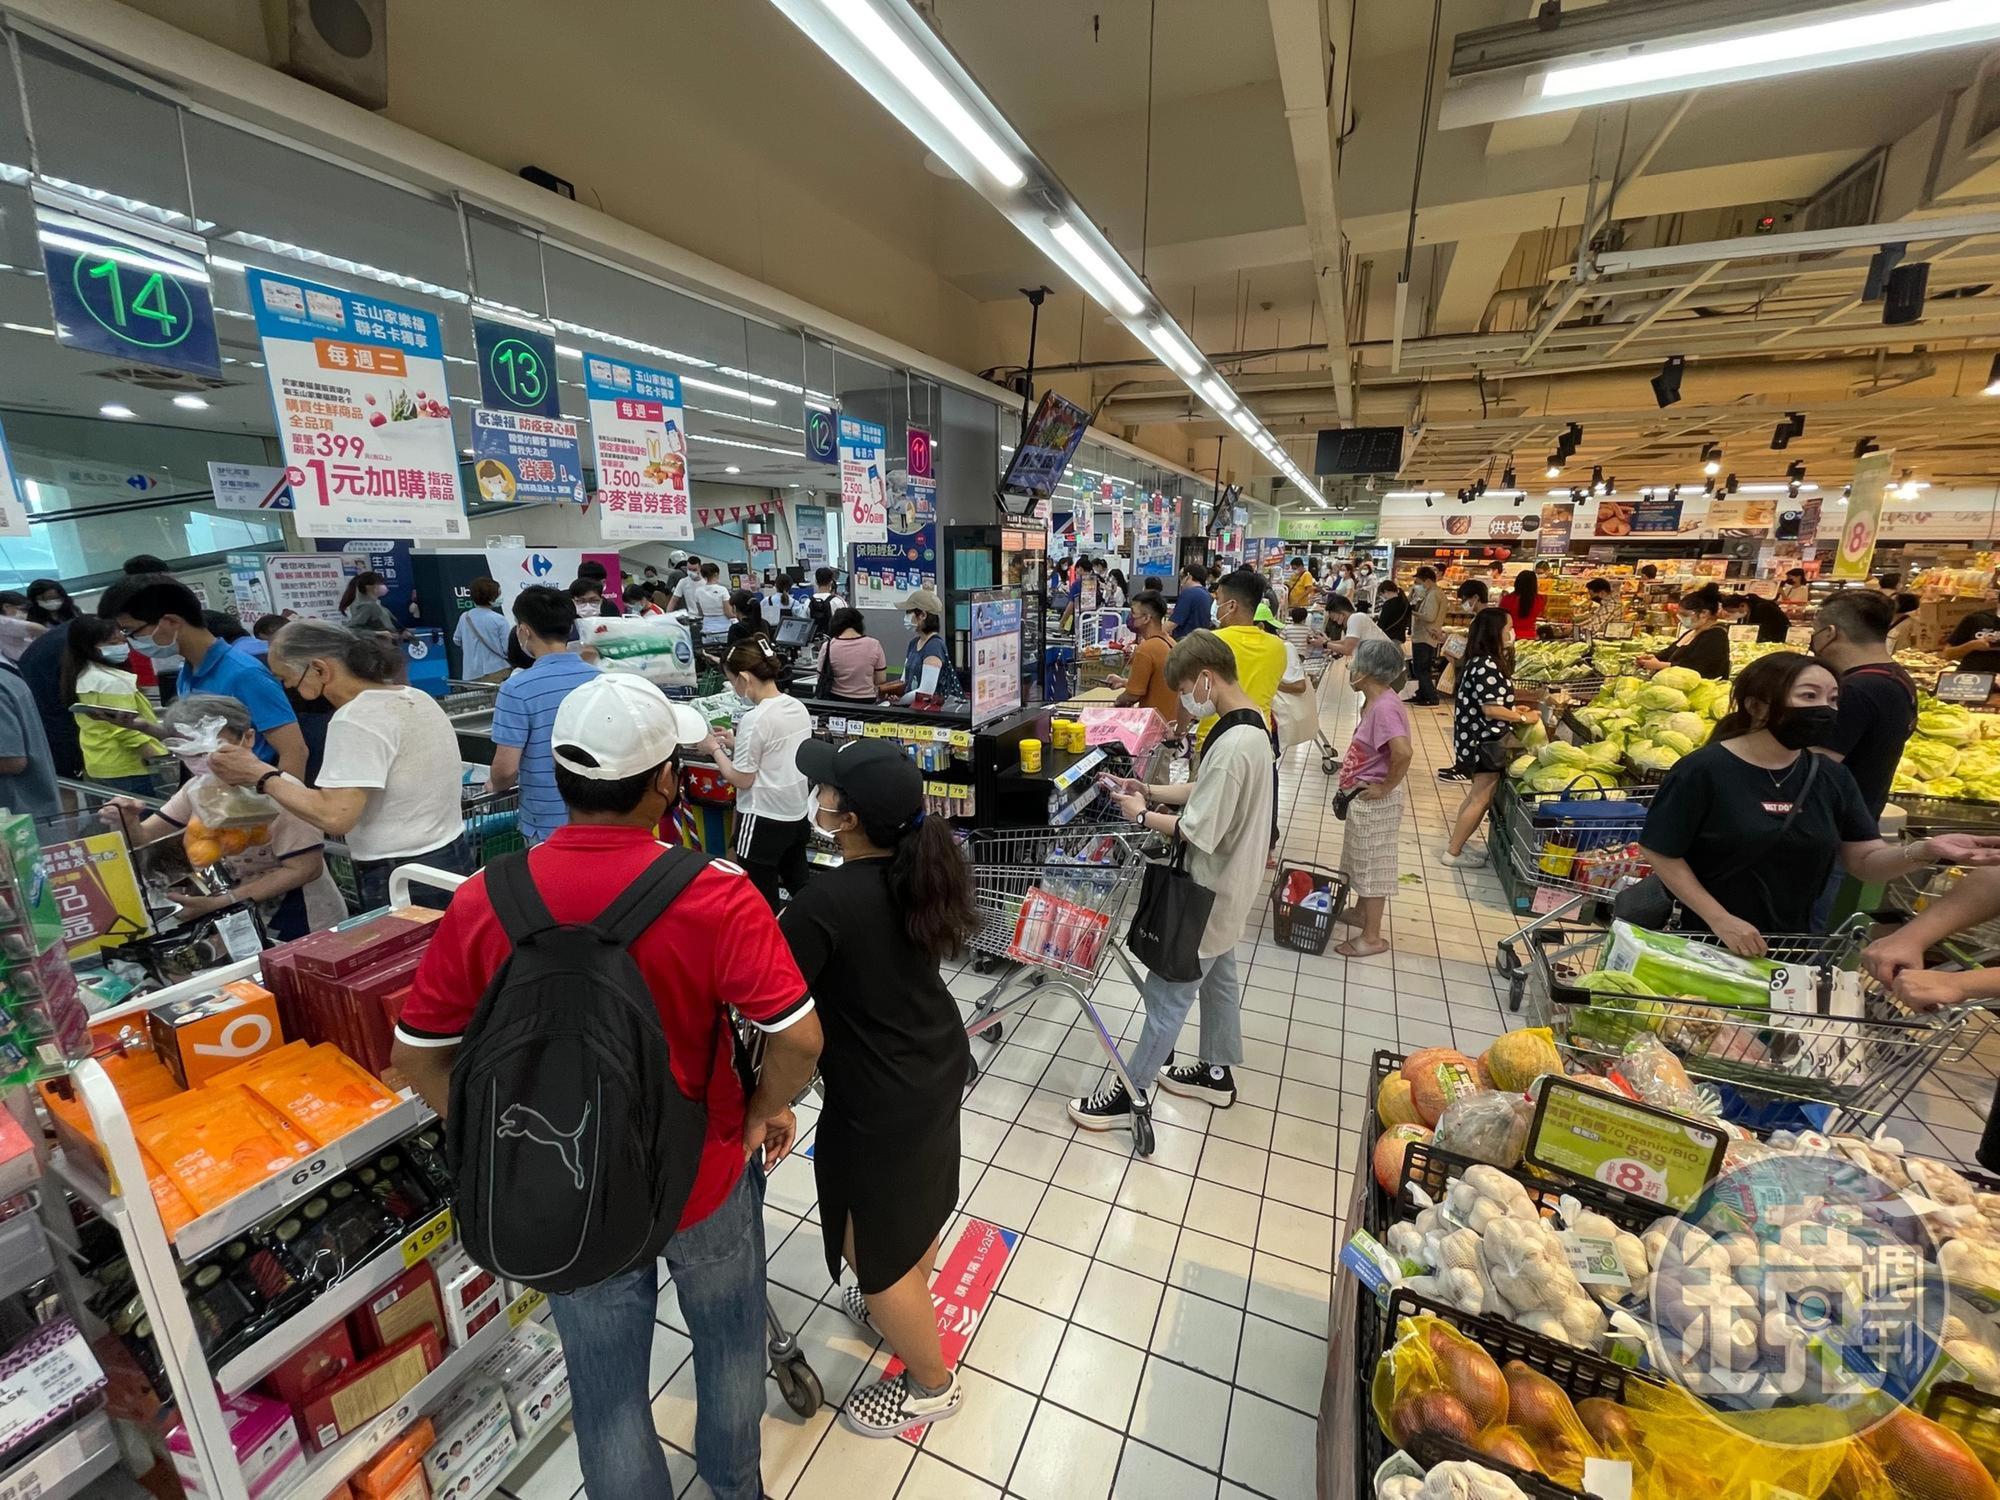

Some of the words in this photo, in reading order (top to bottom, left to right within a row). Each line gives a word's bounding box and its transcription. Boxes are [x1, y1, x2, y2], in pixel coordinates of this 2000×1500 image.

[89, 259, 177, 337] 14
[351, 301, 426, 332] 玉山家樂福
[354, 319, 428, 349] 聯名卡獨享
[327, 344, 399, 372] 每週二
[499, 349, 541, 399] 13
[285, 398, 364, 420] 購買生鮮商品
[621, 402, 660, 419] 每週一
[289, 414, 334, 431] 全品項
[811, 419, 830, 451] 12
[316, 433, 365, 459] 399
[913, 443, 925, 468] 11
[305, 458, 427, 507] 1元加購
[428, 471, 454, 488] 指定
[517, 457, 557, 483] 消毒
[602, 468, 640, 489] 1,500
[429, 486, 455, 501] 商品
[609, 488, 688, 516] 麥當勞套餐
[1490, 520, 1524, 536] 烘焙
[1849, 521, 1866, 554] 8
[372, 555, 396, 568] 生活
[856, 543, 908, 559] 保險經紀人
[953, 734, 965, 742] 69
[1625, 1143, 1667, 1168] 599
[291, 1159, 328, 1186] 69
[408, 1219, 448, 1254] 199
[368, 1405, 410, 1443] 129
